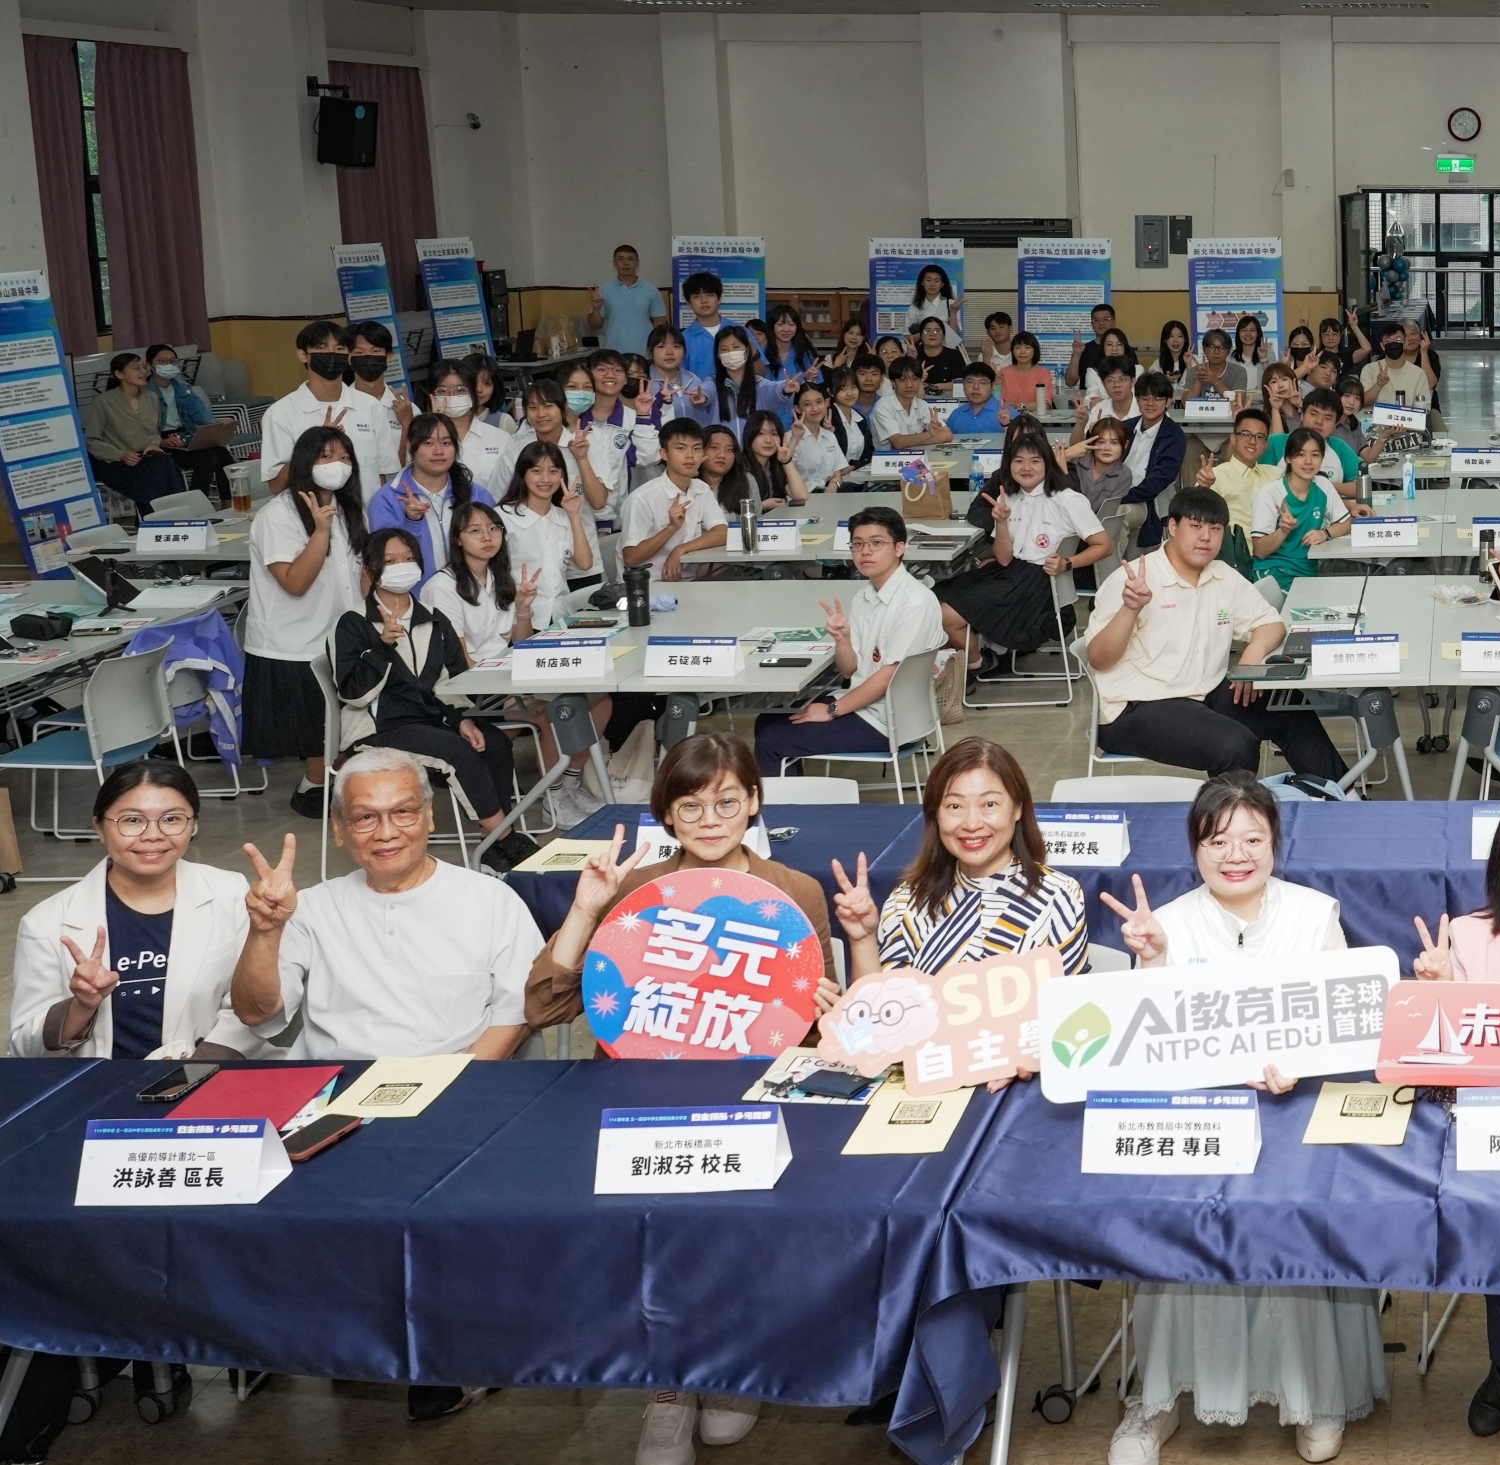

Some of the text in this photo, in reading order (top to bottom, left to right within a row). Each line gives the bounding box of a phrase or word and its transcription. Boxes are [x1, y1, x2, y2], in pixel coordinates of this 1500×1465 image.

[678, 246, 760, 254] 新北市私立竹林高級中學
[154, 534, 190, 543] 雙溪高中
[1367, 530, 1401, 538] 新北高中
[535, 657, 582, 668] 新店高中
[667, 655, 712, 666] 石碇高中
[1333, 652, 1378, 664] 錦和高中
[1071, 841, 1099, 855] 校長
[642, 907, 780, 987] 多元
[117, 951, 169, 972] e-Pe
[1331, 978, 1383, 1009] 全球
[623, 975, 764, 1055] 綻放
[1332, 1007, 1385, 1038] 首推
[1145, 1025, 1322, 1064] NTPC AI EDU
[1117, 1121, 1221, 1131] 新北市教育局中等教育科
[653, 1139, 723, 1150] 新北市板橋高中
[1115, 1136, 1221, 1157] 賴彥君 專員
[127, 1151, 217, 1162] 高優前導計畫北一區
[631, 1153, 742, 1176] 劉淑芬 校長
[112, 1167, 224, 1189] 洪詠善 區長
